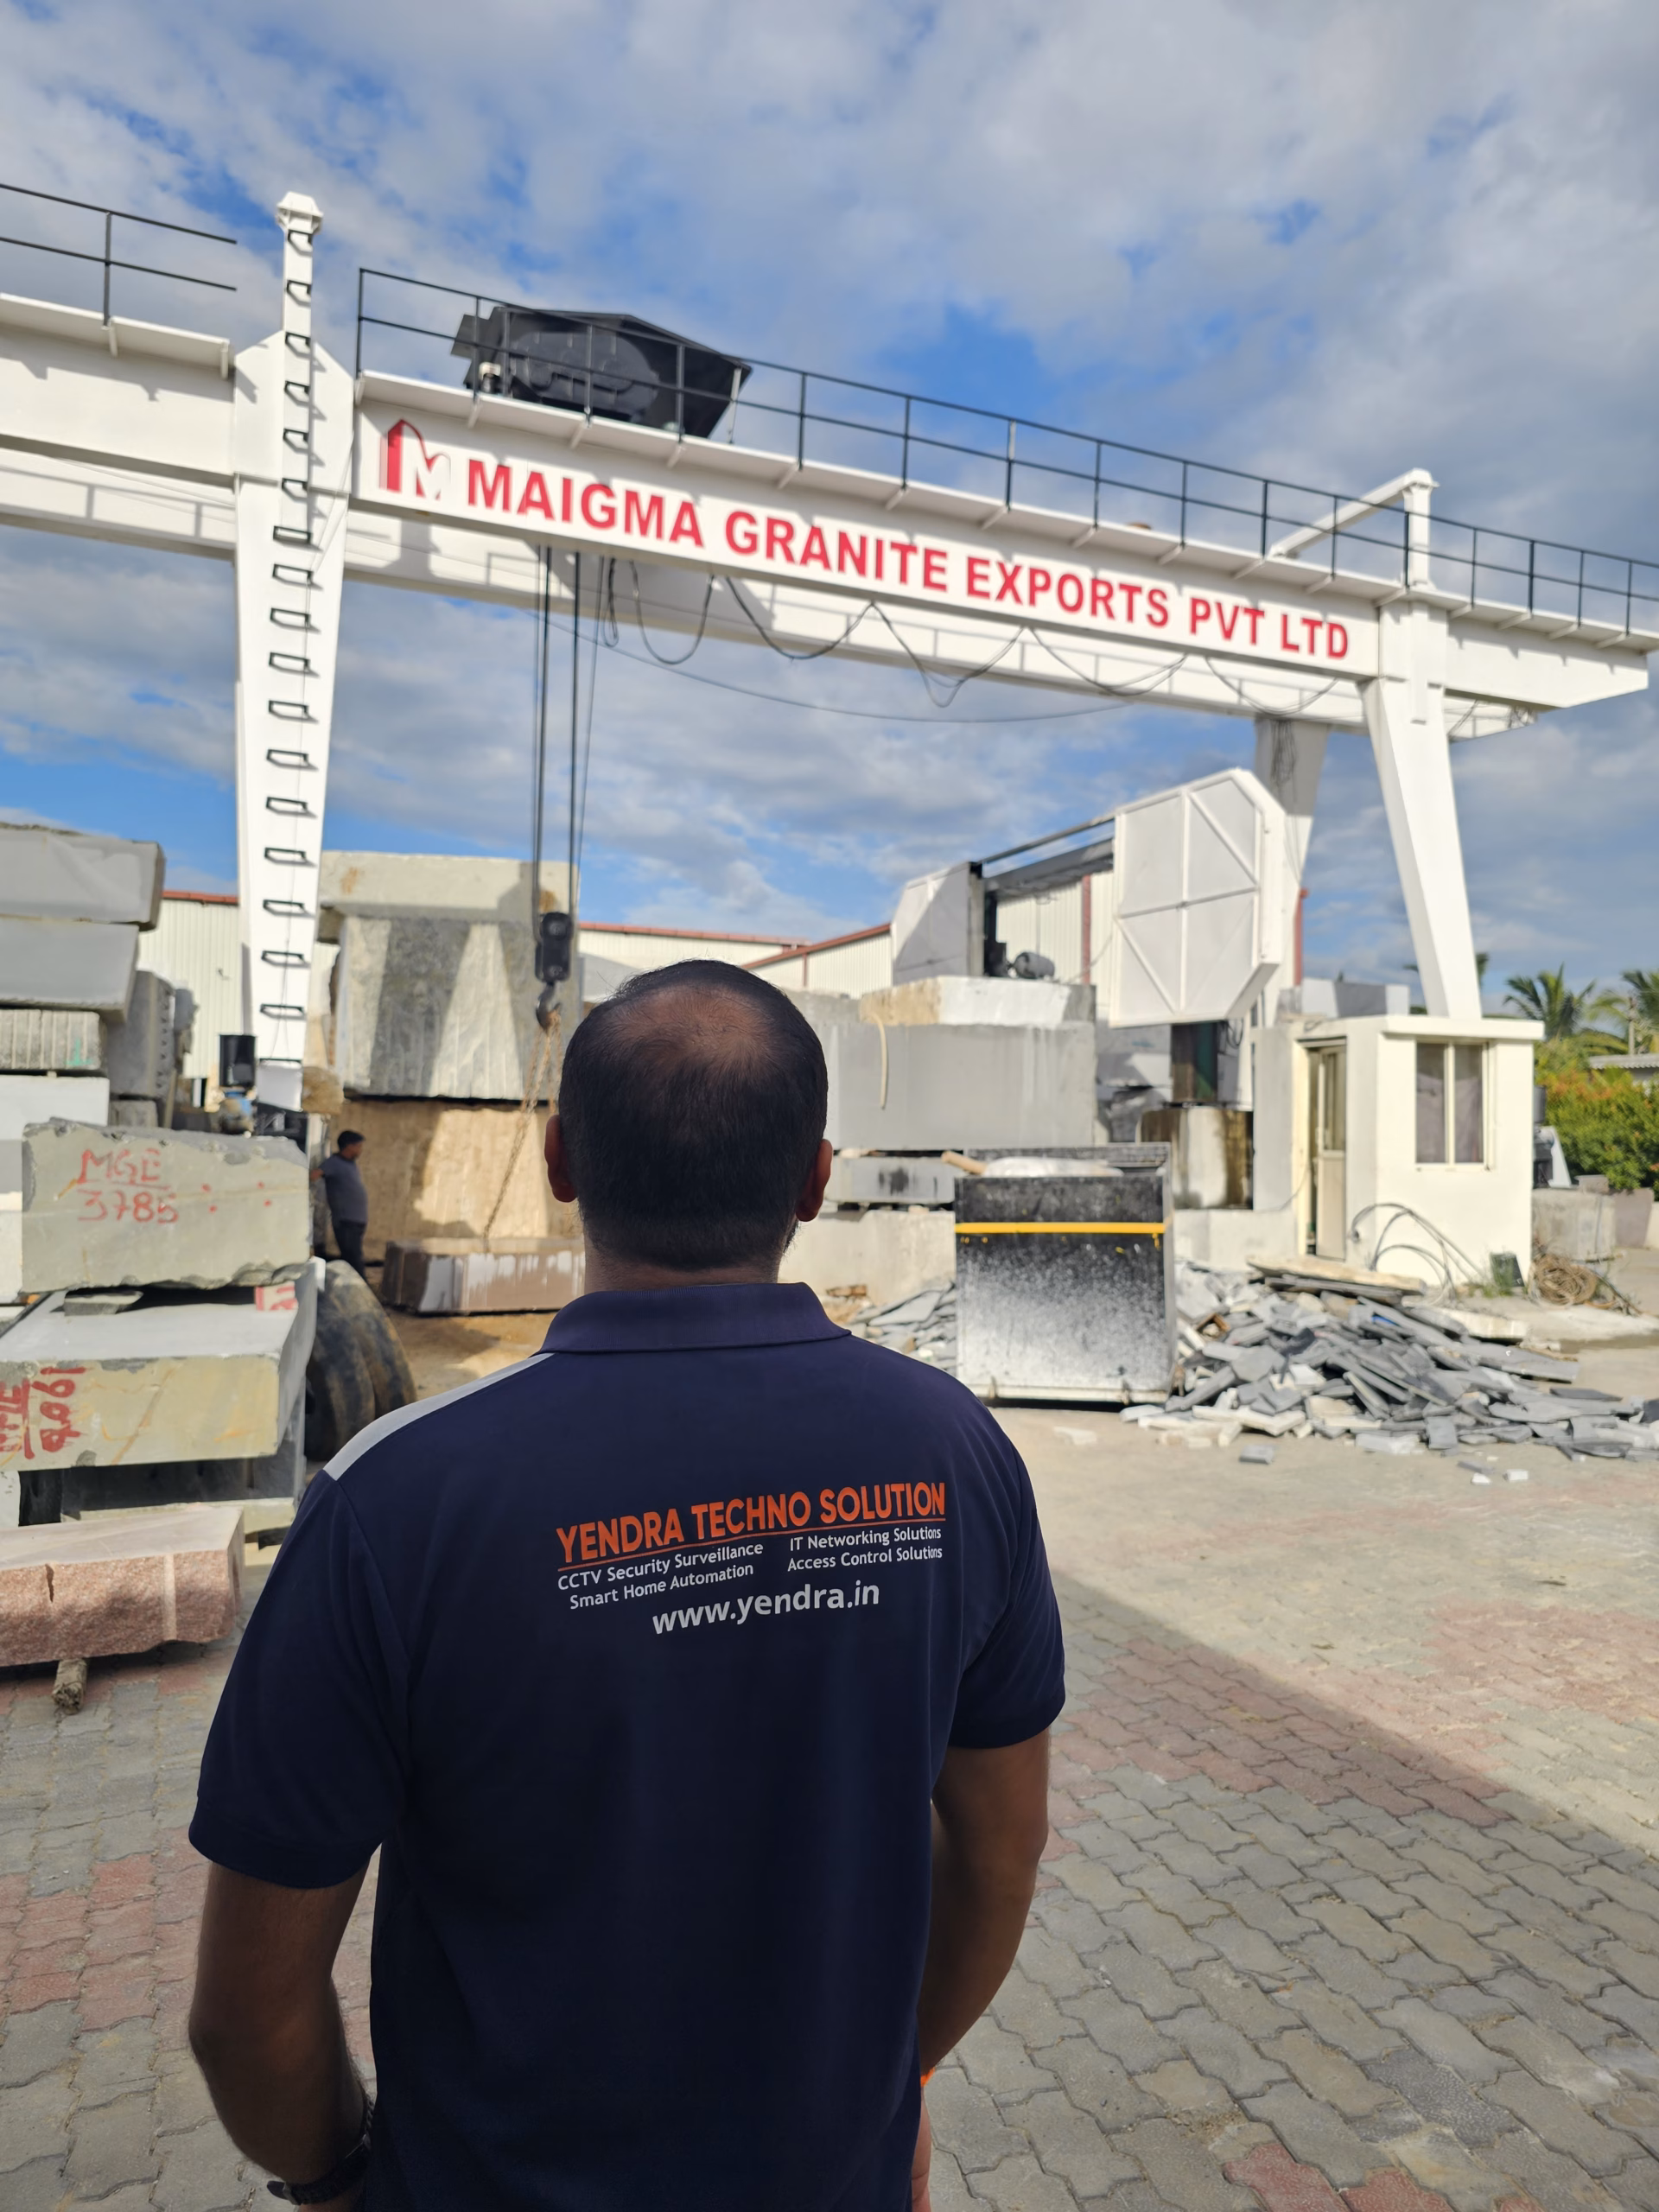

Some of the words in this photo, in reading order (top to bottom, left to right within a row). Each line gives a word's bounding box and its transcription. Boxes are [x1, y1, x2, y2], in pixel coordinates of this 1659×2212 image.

[467, 458, 705, 548] MAIGMA
[725, 510, 948, 593] GRANITE
[966, 556, 1170, 629] EXPORTS
[1189, 597, 1266, 646] PVT
[1280, 614, 1349, 659] LTD
[77, 1147, 161, 1185] MGE
[77, 1189, 179, 1224] 3785
[556, 1508, 684, 1563] YENDRA
[690, 1492, 811, 1540] TECHNO
[819, 1482, 945, 1523] SOLUTION
[790, 1536, 804, 1552] IT
[807, 1529, 890, 1549] Networking
[893, 1525, 942, 1542] Solutions
[557, 1569, 602, 1591] CCTV
[607, 1558, 671, 1582] Security
[674, 1543, 764, 1568] Surveillance
[787, 1556, 836, 1573] Access
[840, 1548, 893, 1567] Control
[896, 1546, 943, 1562] Solutions
[569, 1588, 620, 1610] Smart
[623, 1580, 667, 1600] Home
[670, 1564, 754, 1591] Automation
[652, 1580, 880, 1635] www.yendra.in
